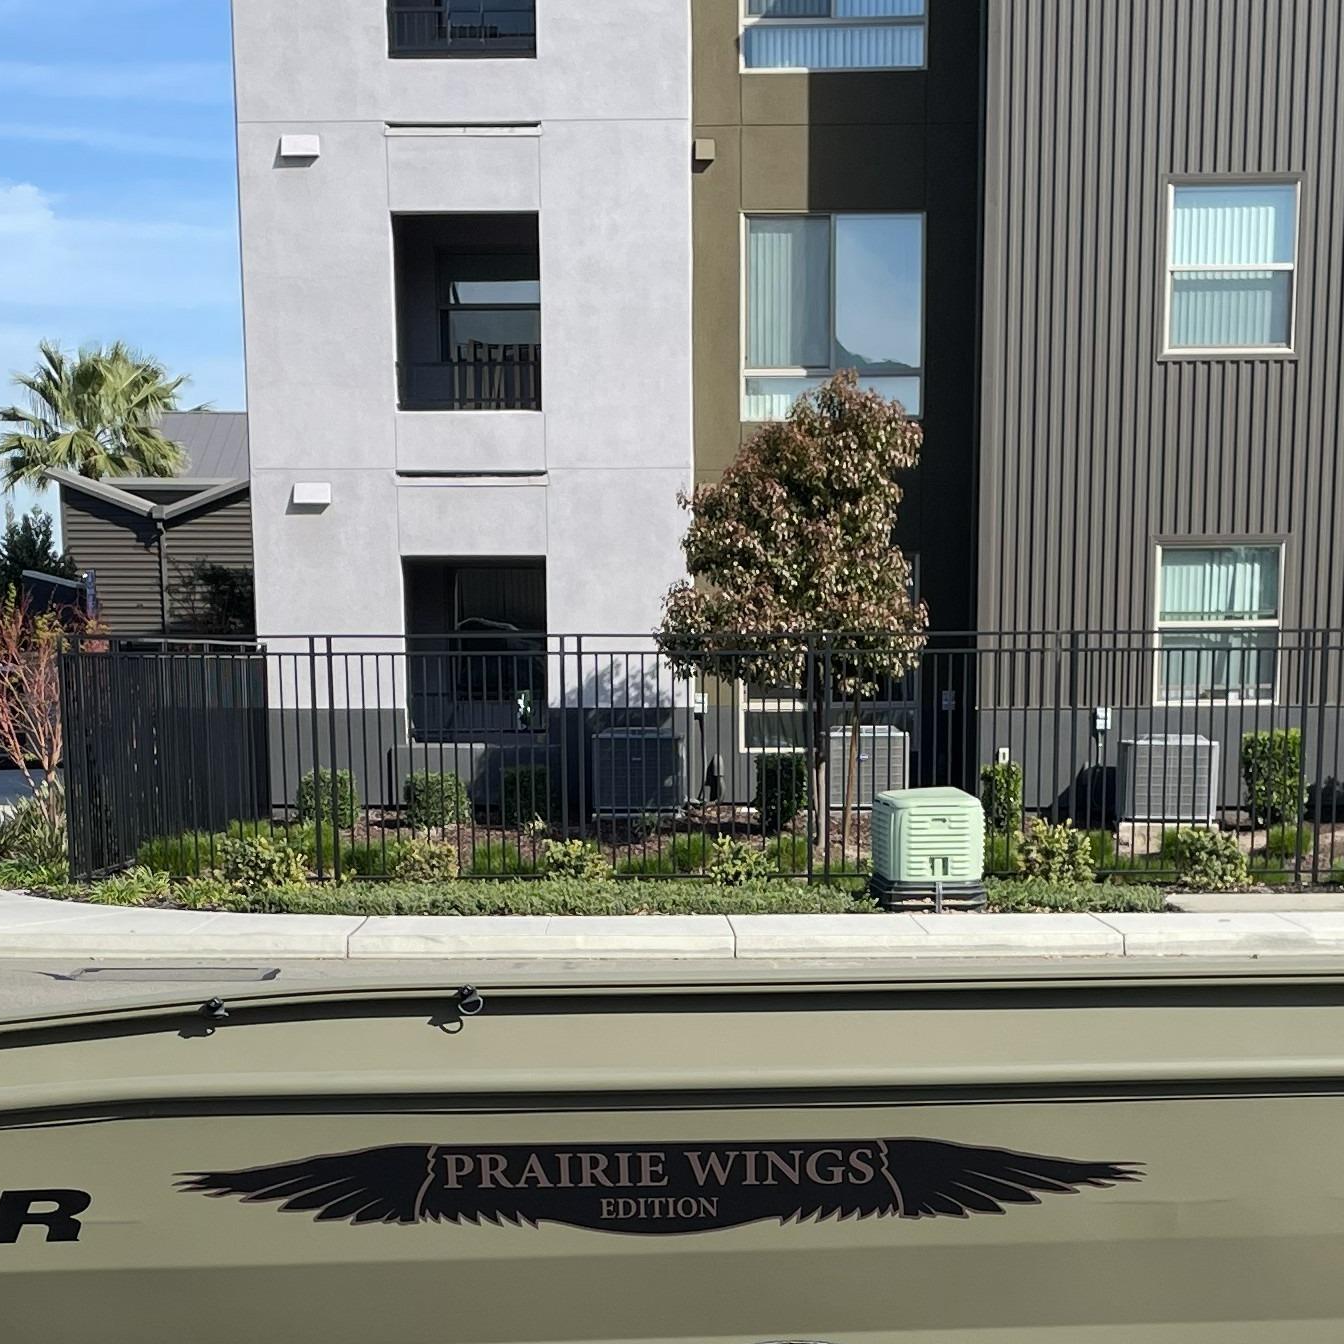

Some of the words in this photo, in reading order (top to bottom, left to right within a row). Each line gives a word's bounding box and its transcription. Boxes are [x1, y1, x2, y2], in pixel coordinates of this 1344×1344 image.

[443, 1151, 668, 1189] PRAIRIE
[684, 1149, 875, 1186] WINGS
[600, 1197, 719, 1219] EDITION
